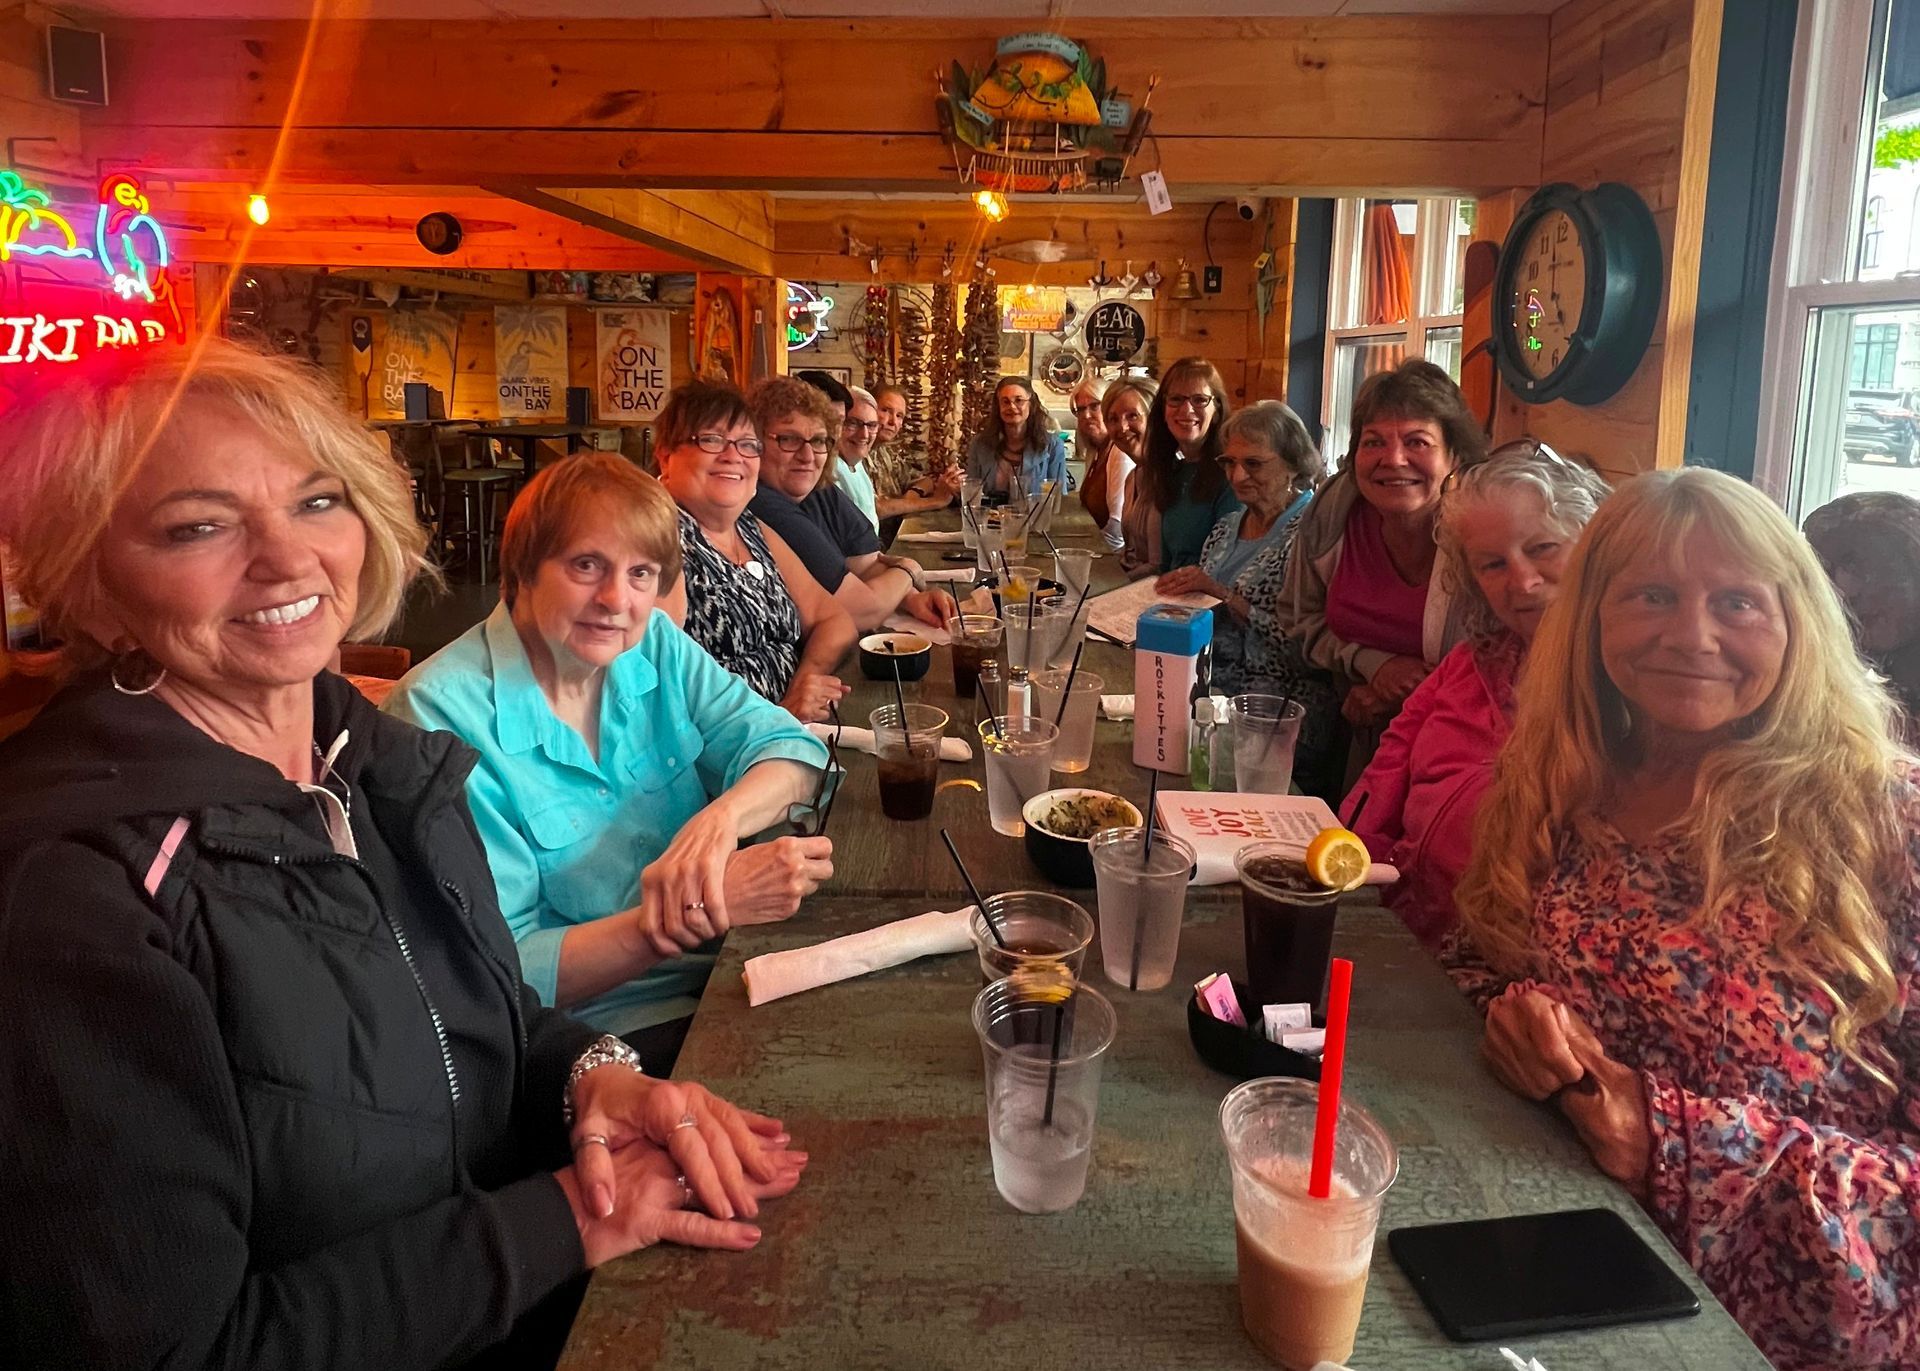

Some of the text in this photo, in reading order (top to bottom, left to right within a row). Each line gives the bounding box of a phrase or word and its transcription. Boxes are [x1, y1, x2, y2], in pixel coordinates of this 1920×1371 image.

[1556, 221, 1569, 244] 12
[1540, 235, 1550, 255] 11
[1528, 261, 1539, 281] 10
[1095, 306, 1138, 329] EAT
[0, 314, 84, 363] IKI
[385, 352, 414, 369] ON
[619, 346, 656, 366] ON
[616, 368, 664, 388] THE
[384, 384, 405, 401] BA
[499, 385, 551, 398] ON THE
[620, 391, 664, 410] BAY
[524, 398, 551, 411] BAY
[1154, 655, 1167, 762] ROCKETTES
[1181, 807, 1219, 837] LOVE
[1209, 807, 1252, 838] JOY
[1241, 808, 1277, 839] PEACE
